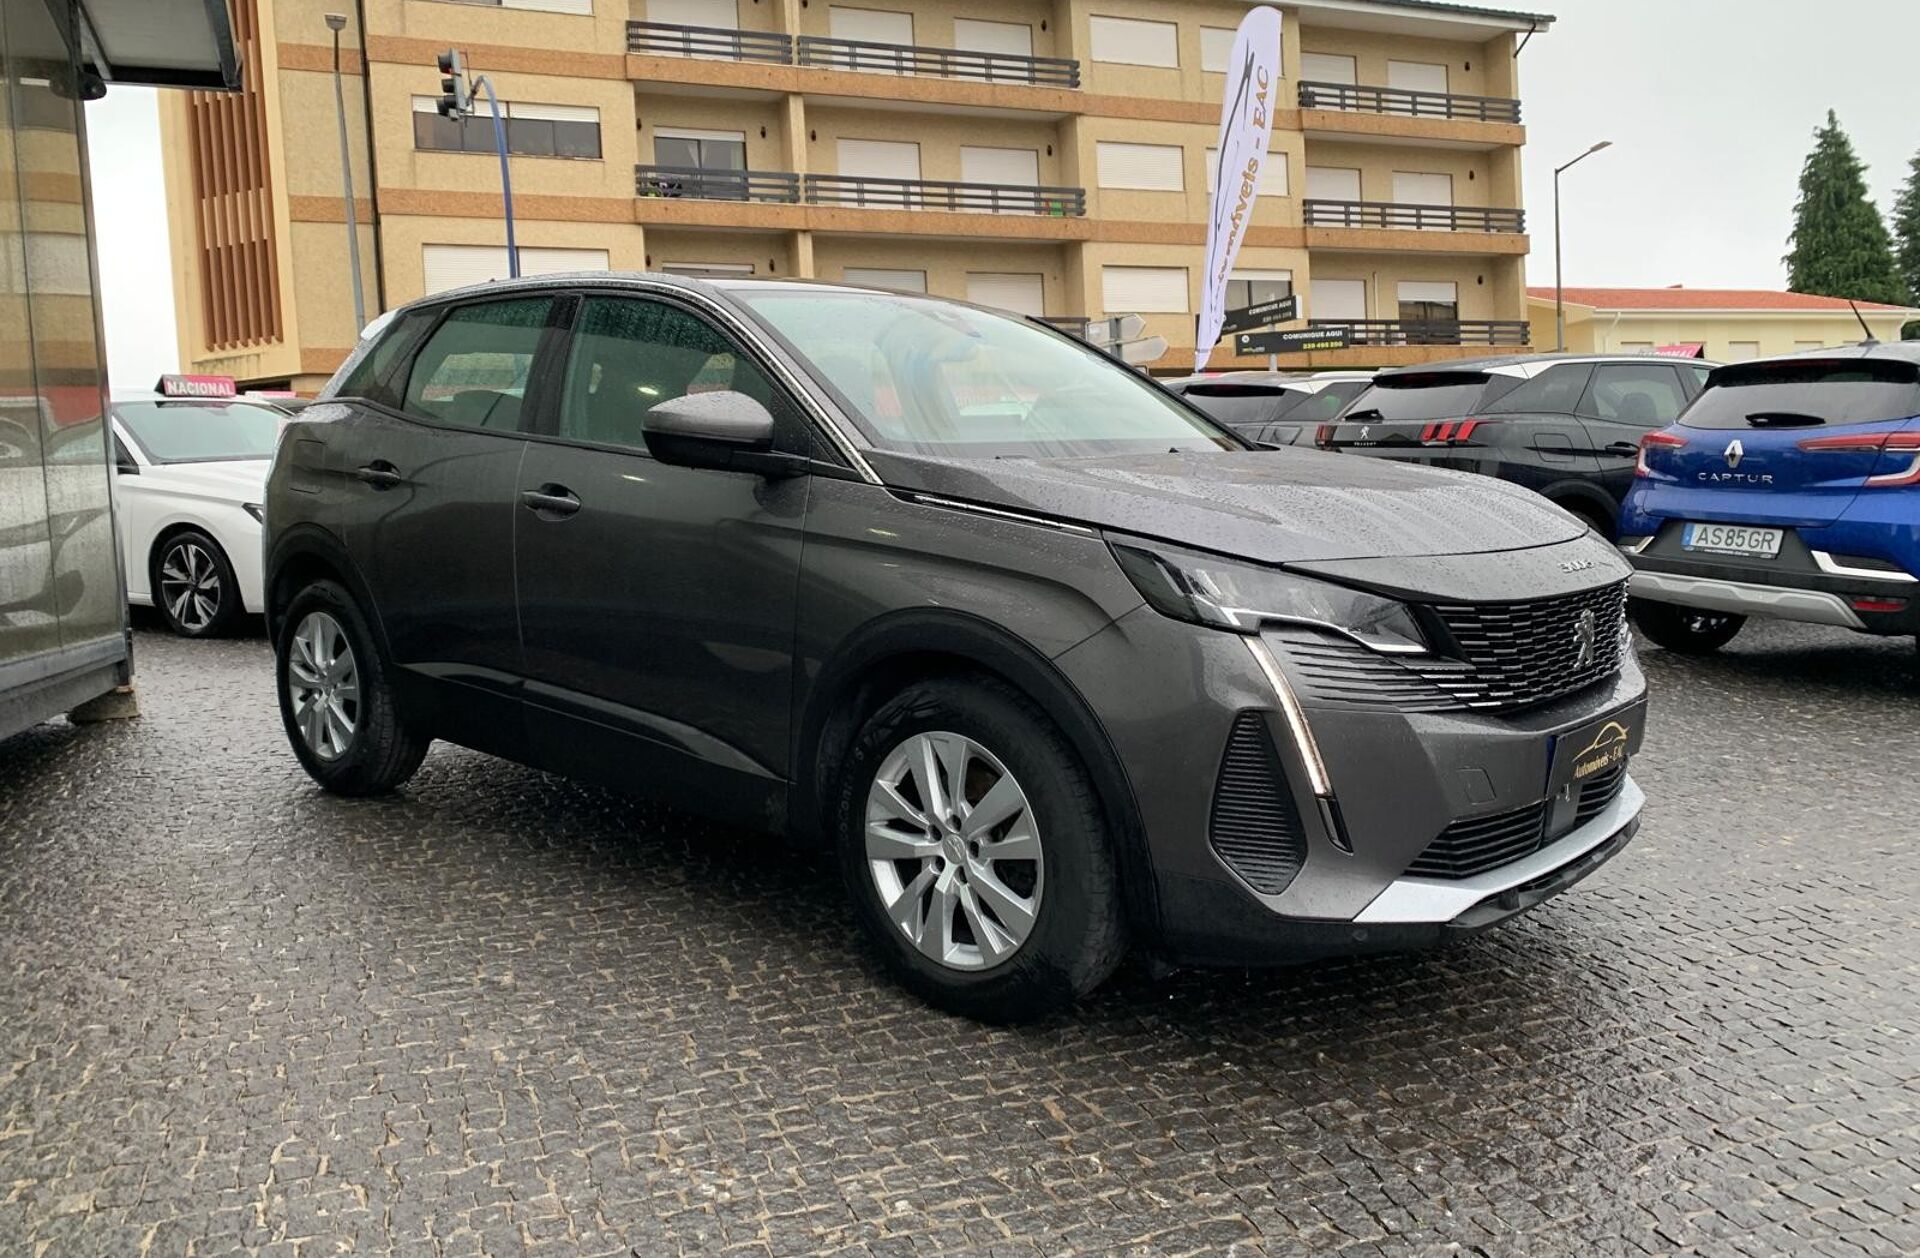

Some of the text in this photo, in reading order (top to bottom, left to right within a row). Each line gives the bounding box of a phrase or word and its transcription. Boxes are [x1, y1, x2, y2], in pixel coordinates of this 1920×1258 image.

[1253, 65, 1270, 130] EAC
[1282, 332, 1325, 340] COMUNIQUE
[166, 382, 234, 396] NACIONAL
[1698, 472, 1773, 484] CAPTUR
[1696, 526, 1775, 551] AS85GR
